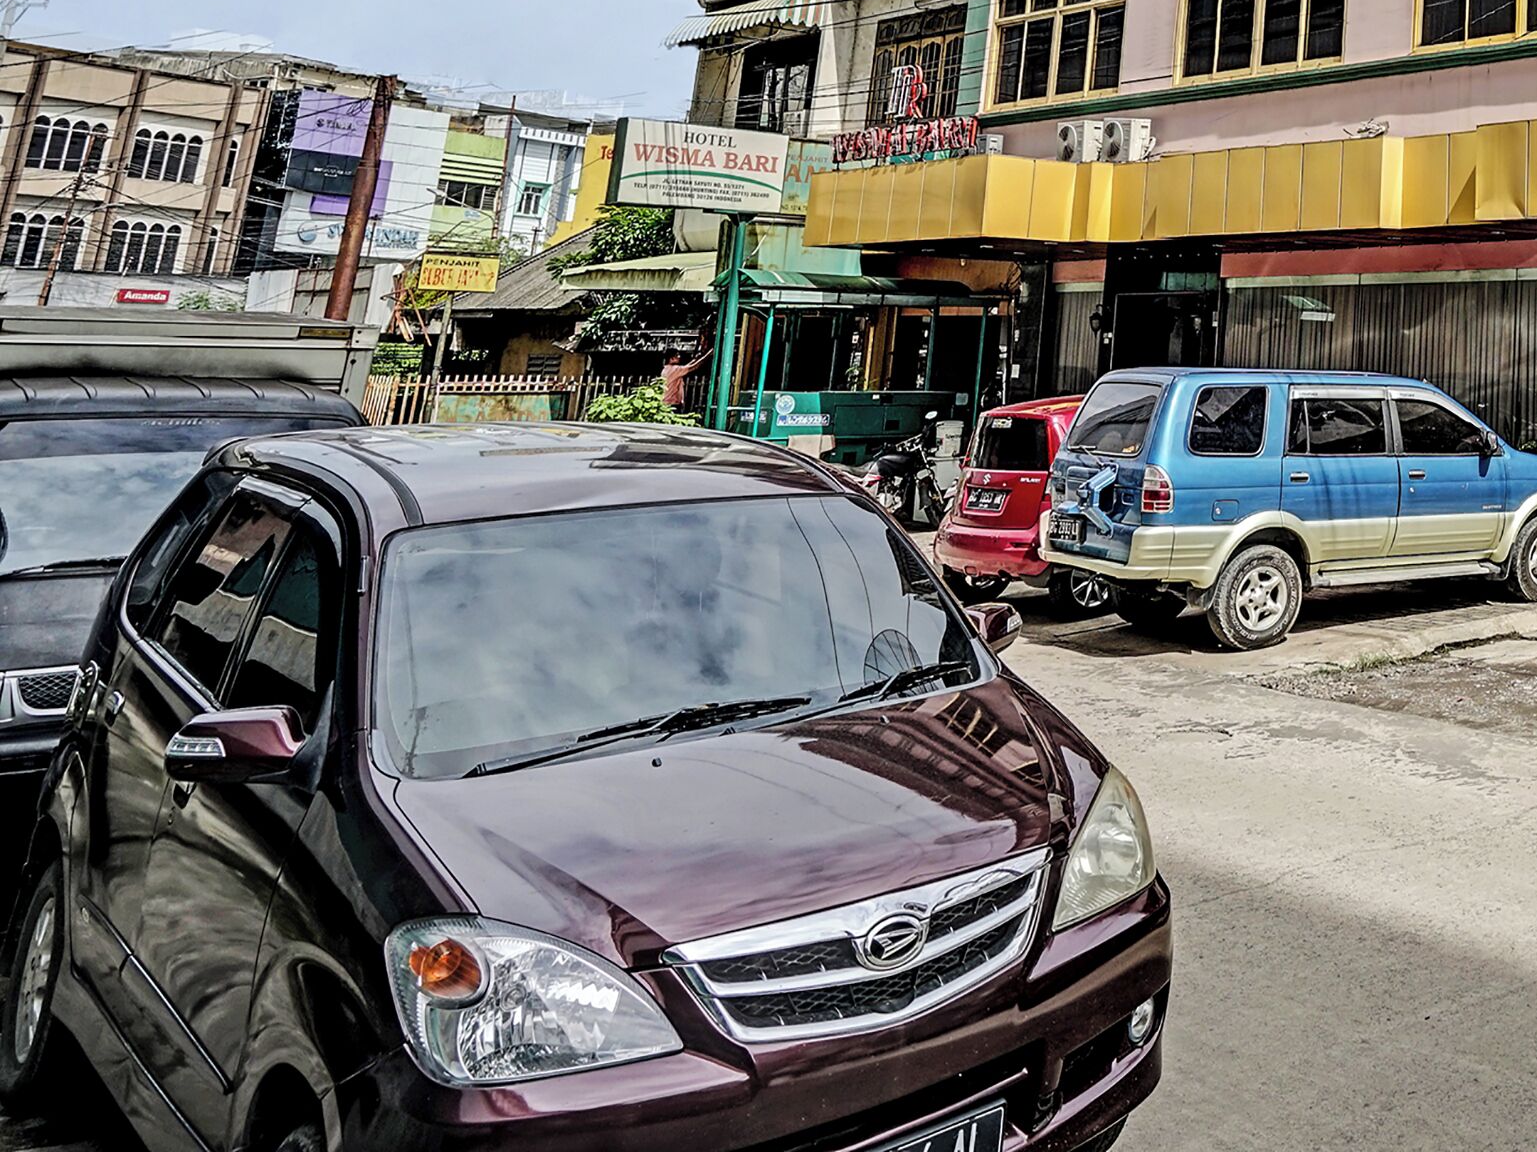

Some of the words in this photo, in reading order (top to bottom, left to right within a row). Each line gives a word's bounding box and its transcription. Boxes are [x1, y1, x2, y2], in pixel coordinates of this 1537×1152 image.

[684, 131, 737, 148] HOTEL
[633, 143, 716, 168] WISMA
[723, 152, 779, 173] BARI
[426, 258, 480, 267] PENJAHIT
[124, 291, 166, 300] Amanda
